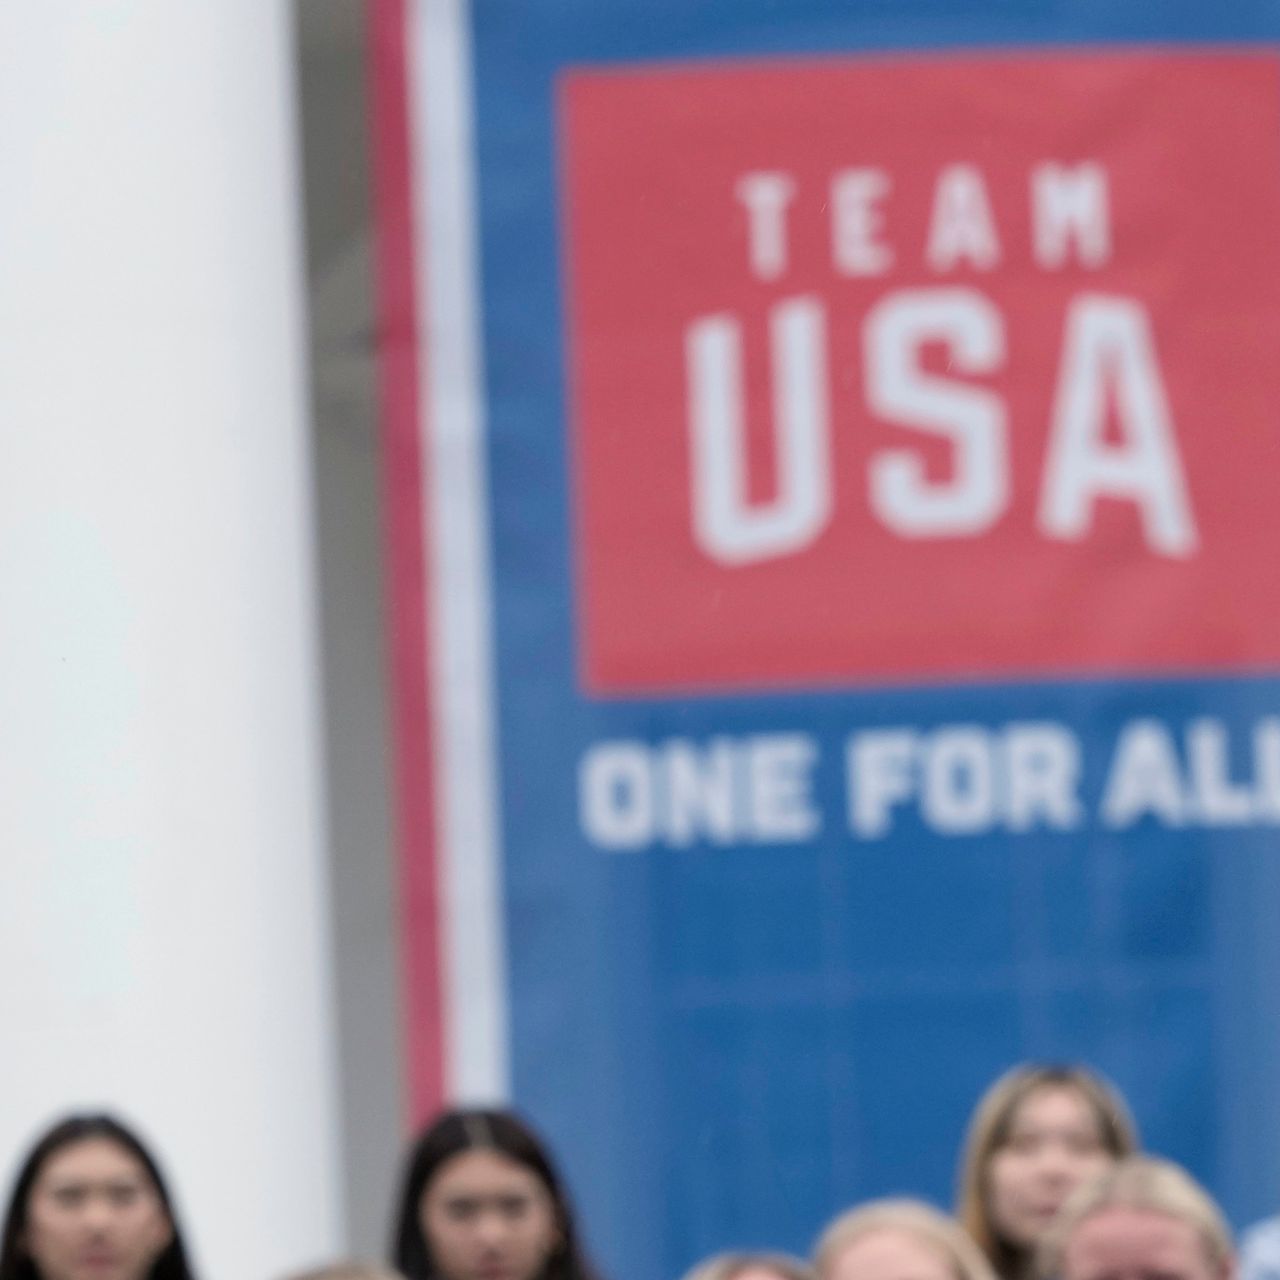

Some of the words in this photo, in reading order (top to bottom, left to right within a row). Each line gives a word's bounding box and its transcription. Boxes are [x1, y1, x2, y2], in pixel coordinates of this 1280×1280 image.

[738, 161, 1111, 280] TEAM
[686, 286, 1200, 567] USA
[579, 729, 818, 851] ONE
[848, 726, 1080, 837] FOR
